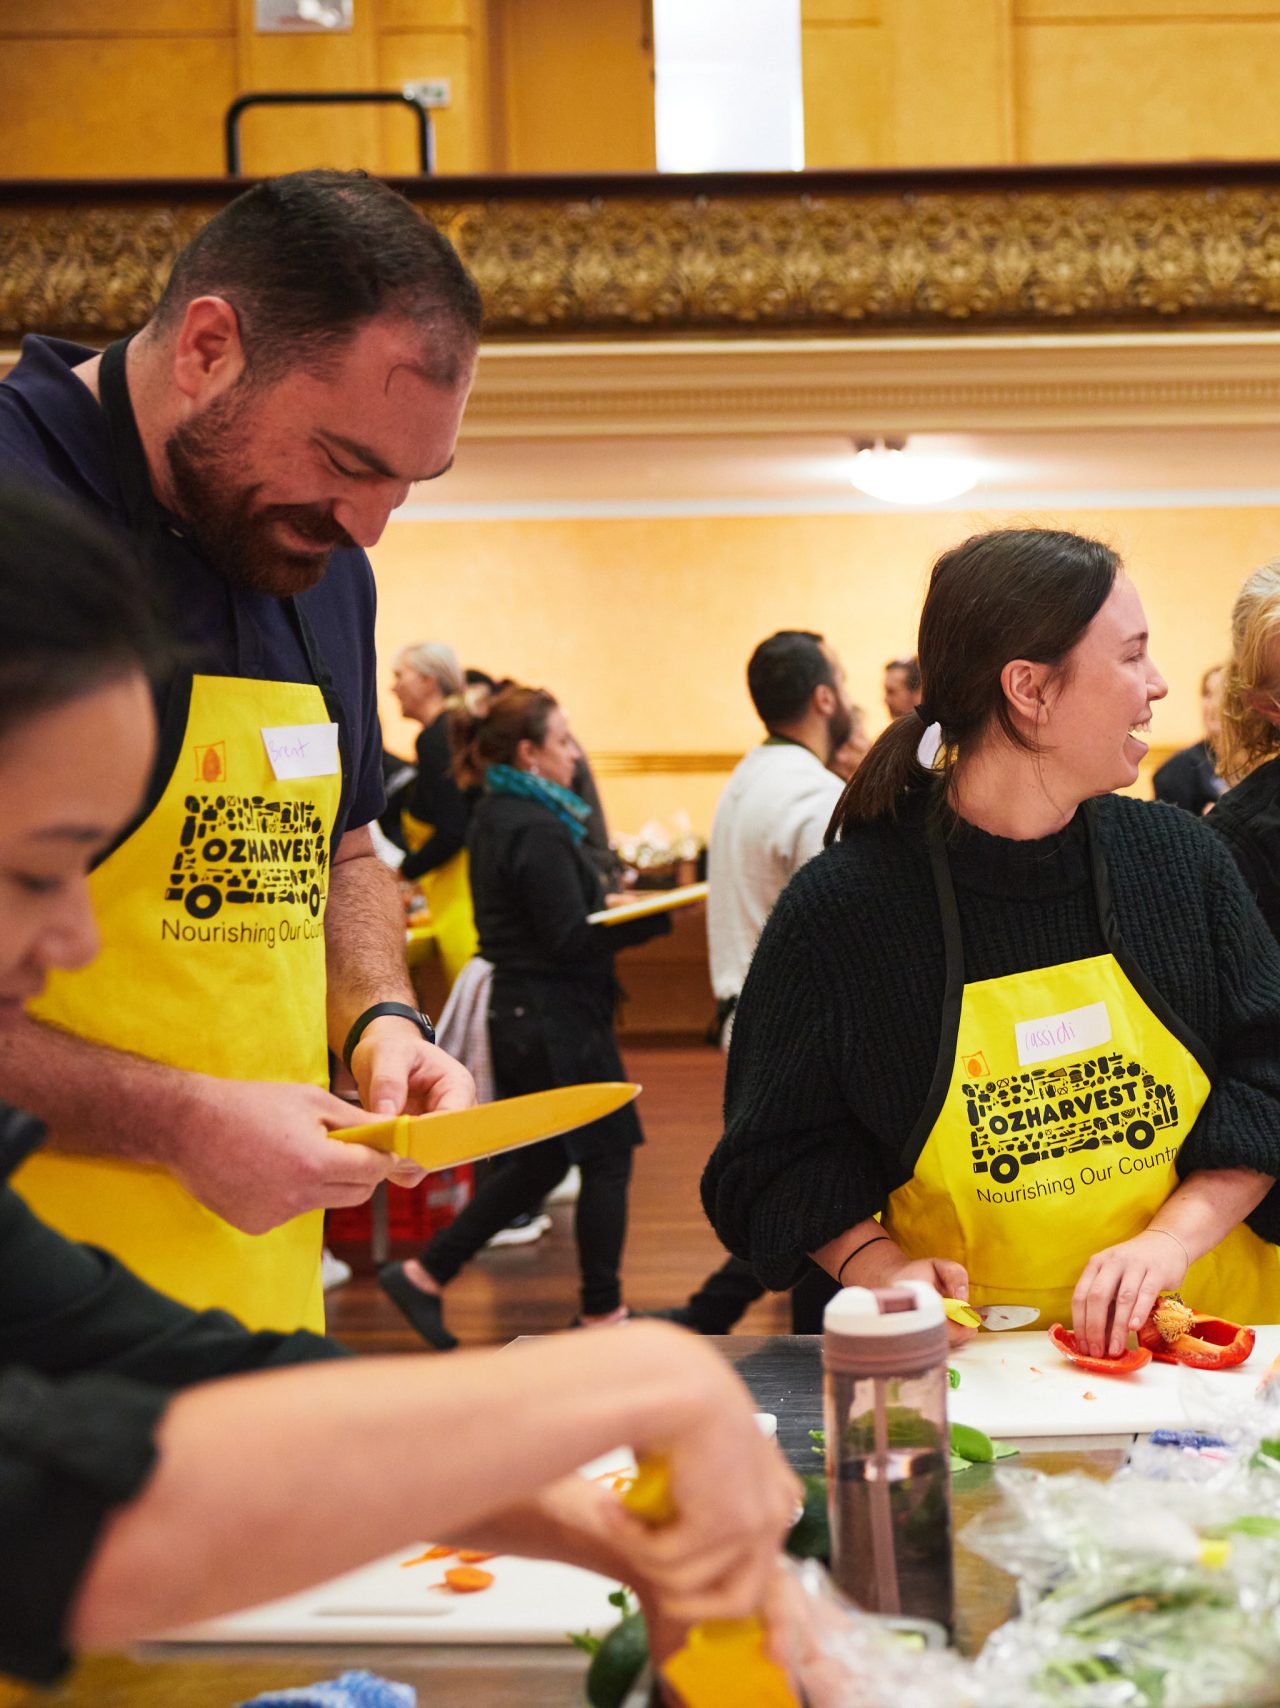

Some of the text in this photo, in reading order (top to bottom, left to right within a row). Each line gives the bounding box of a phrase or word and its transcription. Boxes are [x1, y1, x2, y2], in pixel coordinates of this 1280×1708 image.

[162, 918, 275, 949] Nourishing
[279, 920, 301, 942] Our
[988, 1081, 1138, 1136] OZHARVEST
[976, 1146, 1178, 1204] Nourishing Our Countr
